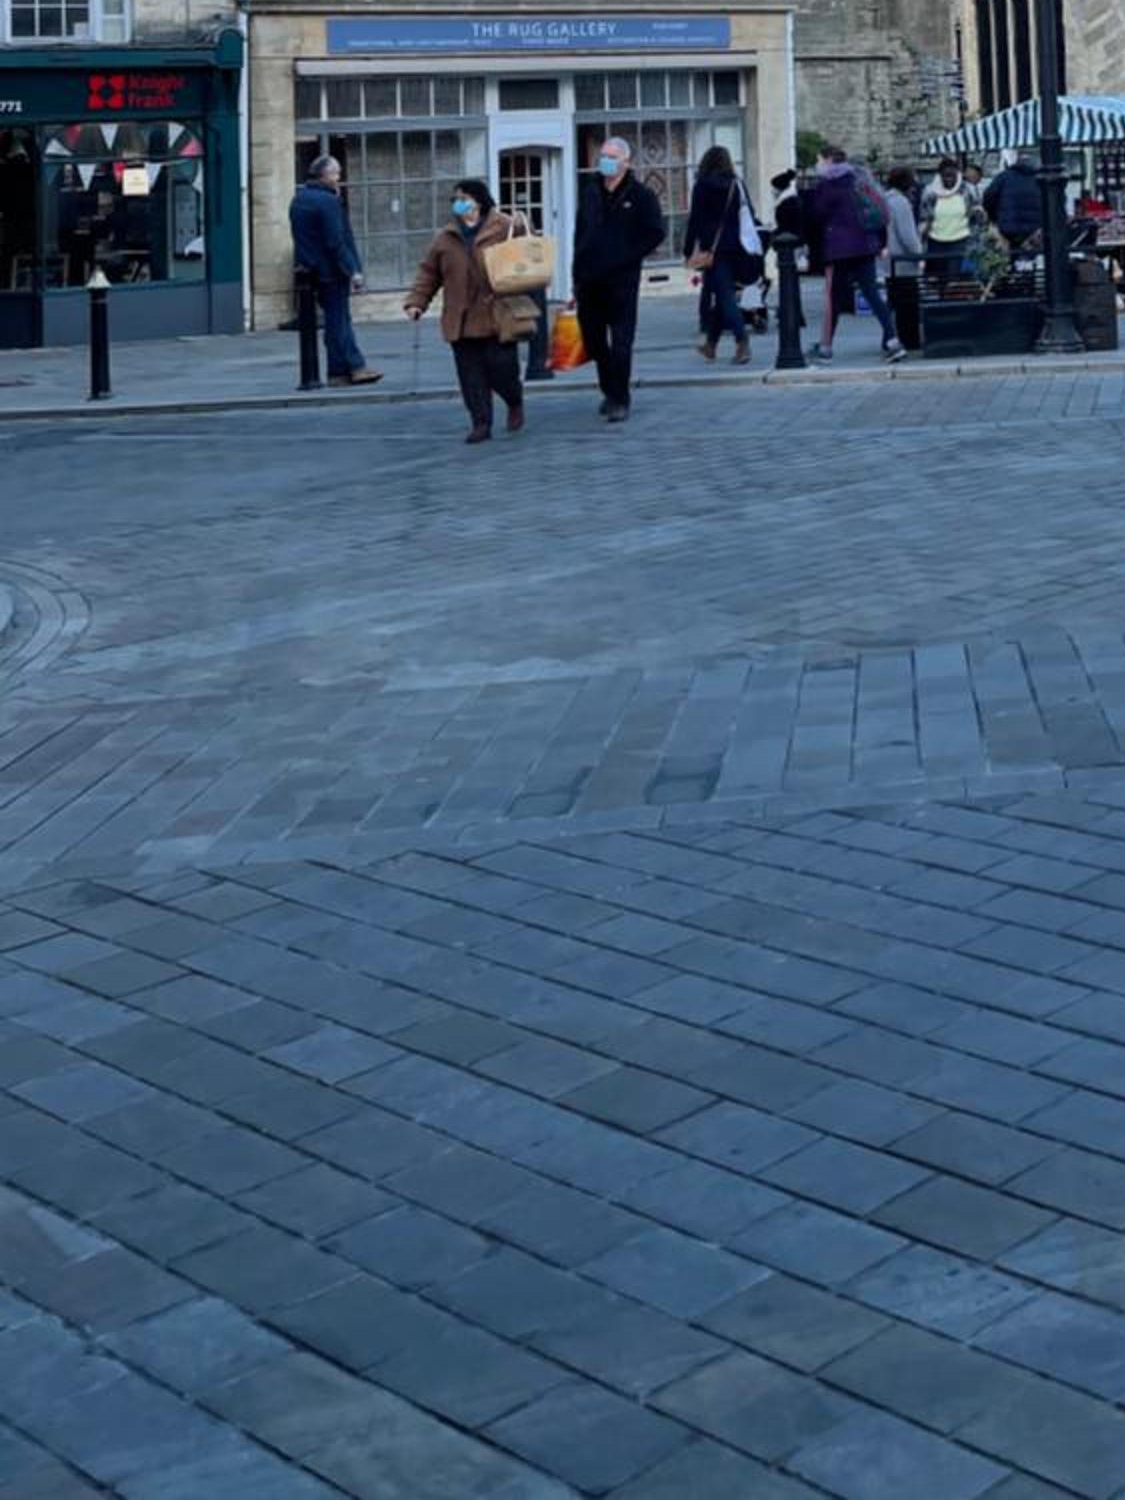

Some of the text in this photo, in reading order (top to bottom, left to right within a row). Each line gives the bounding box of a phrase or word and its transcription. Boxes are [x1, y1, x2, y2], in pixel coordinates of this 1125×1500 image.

[472, 21, 617, 37] THE RUG GALLERY
